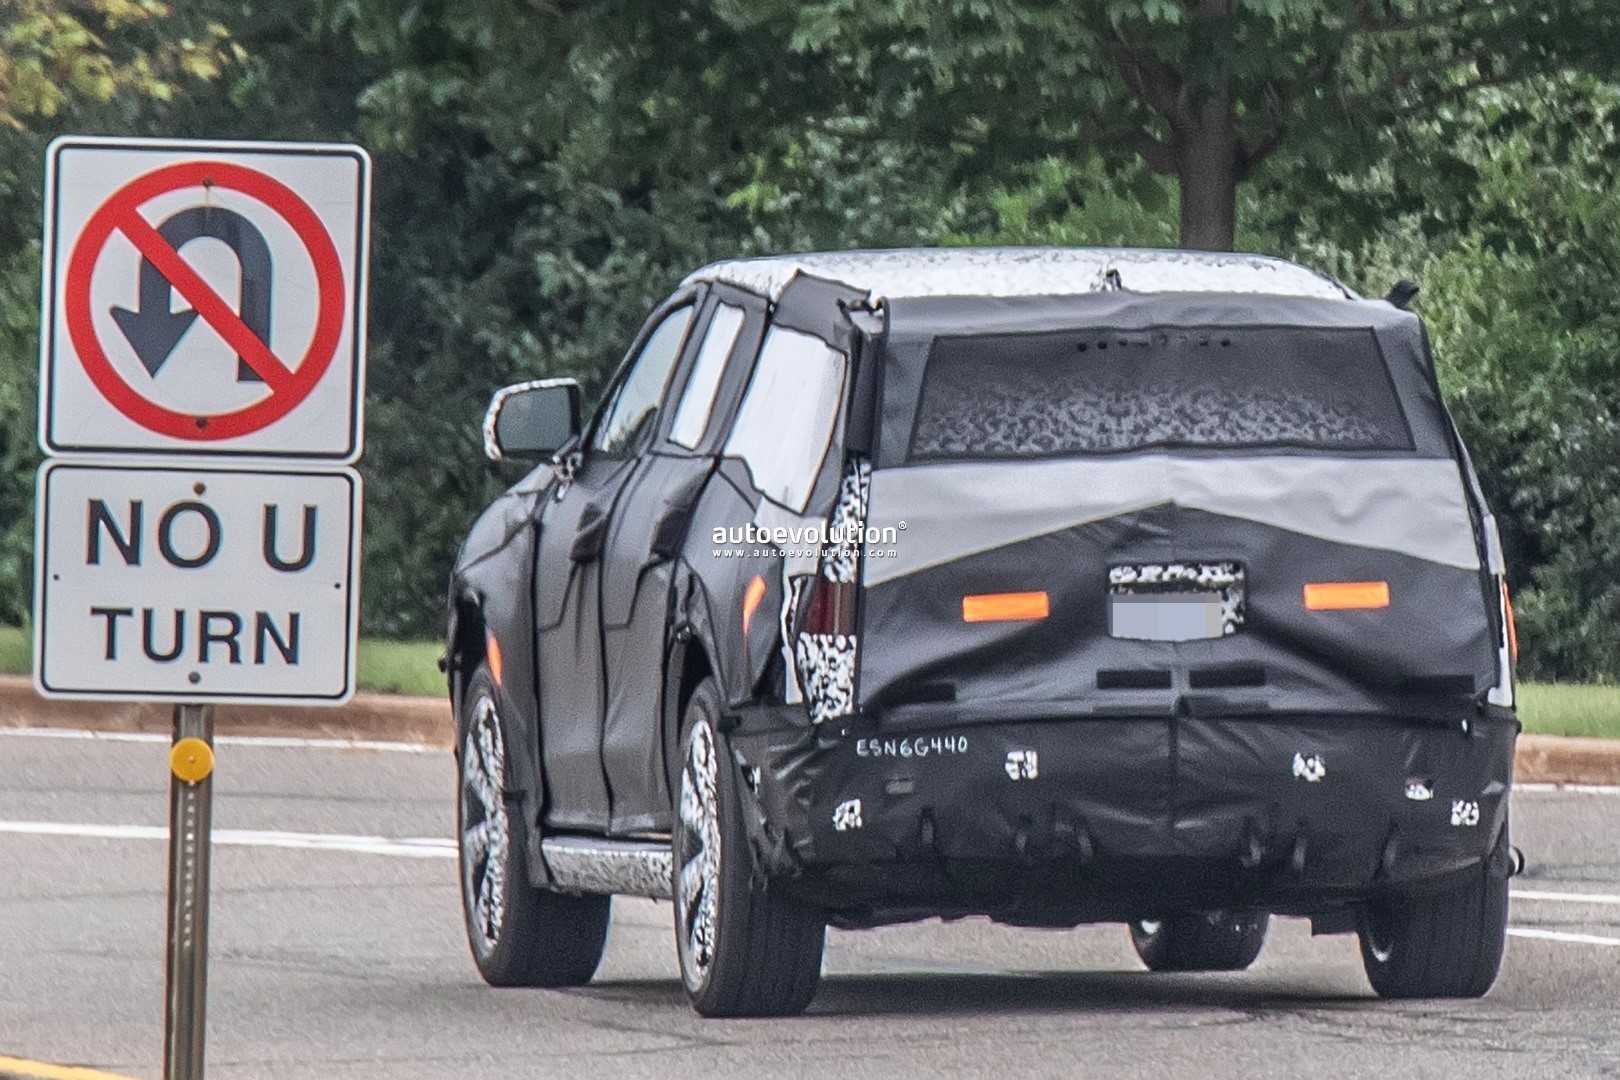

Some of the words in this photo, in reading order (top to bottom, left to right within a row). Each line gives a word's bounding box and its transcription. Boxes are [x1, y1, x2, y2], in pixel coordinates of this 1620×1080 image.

[85, 498, 223, 568] NO
[261, 503, 317, 572] U
[90, 607, 300, 665] TURN
